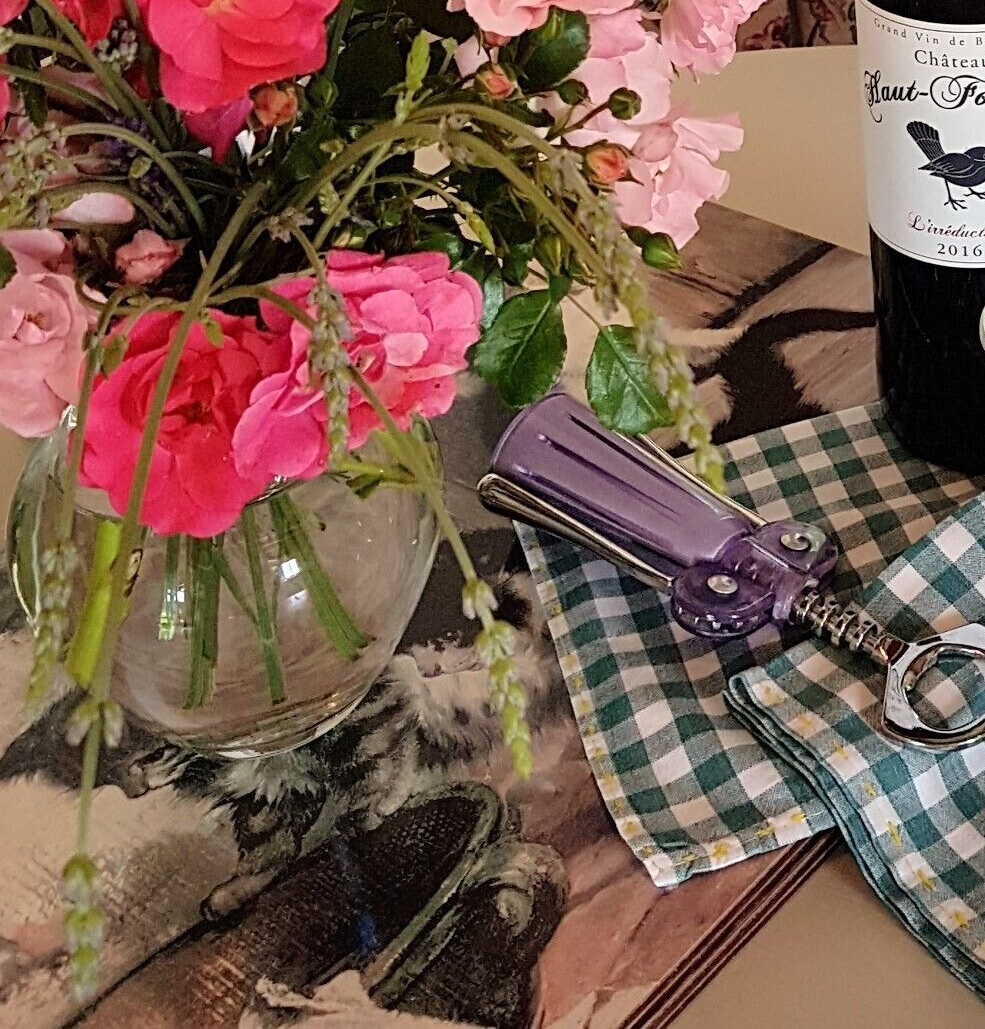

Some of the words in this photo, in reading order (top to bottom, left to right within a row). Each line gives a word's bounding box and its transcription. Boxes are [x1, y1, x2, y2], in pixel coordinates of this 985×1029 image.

[873, 18, 908, 39] Grand
[915, 31, 940, 45] Vin
[949, 36, 966, 46] de
[936, 242, 984, 258] 2016
